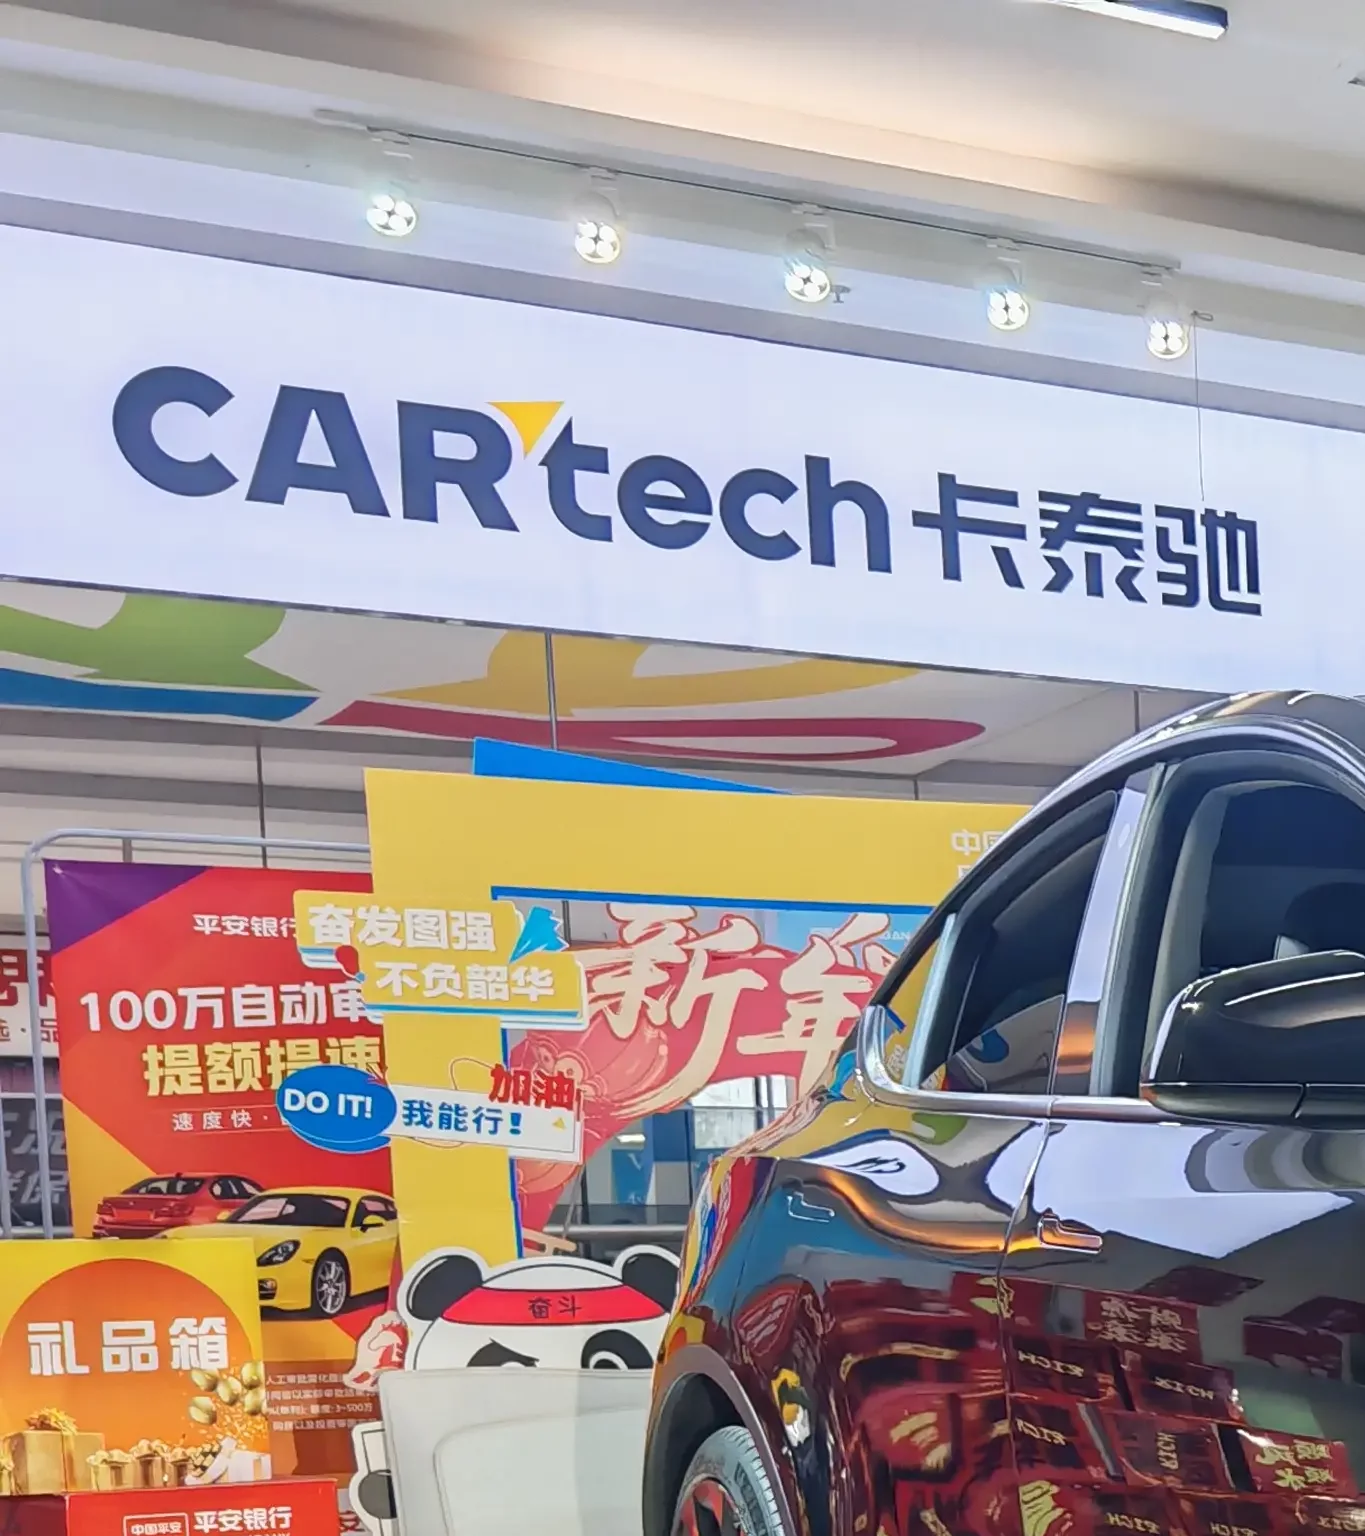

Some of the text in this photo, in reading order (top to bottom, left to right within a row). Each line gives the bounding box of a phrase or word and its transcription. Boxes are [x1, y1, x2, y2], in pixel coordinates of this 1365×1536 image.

[112, 365, 1264, 617] CARtech 卡泰驰
[308, 904, 497, 953] 奋发图强
[375, 961, 555, 1003] 不负韶华
[141, 1034, 384, 1097] 提额提速
[488, 1064, 579, 1111] 加油
[283, 1087, 373, 1119] DO IT!
[527, 1295, 581, 1319] 奋斗
[27, 1316, 229, 1377] 礼品箱
[130, 1521, 183, 1536] 中国平安
[193, 1506, 293, 1533] 平安银行
